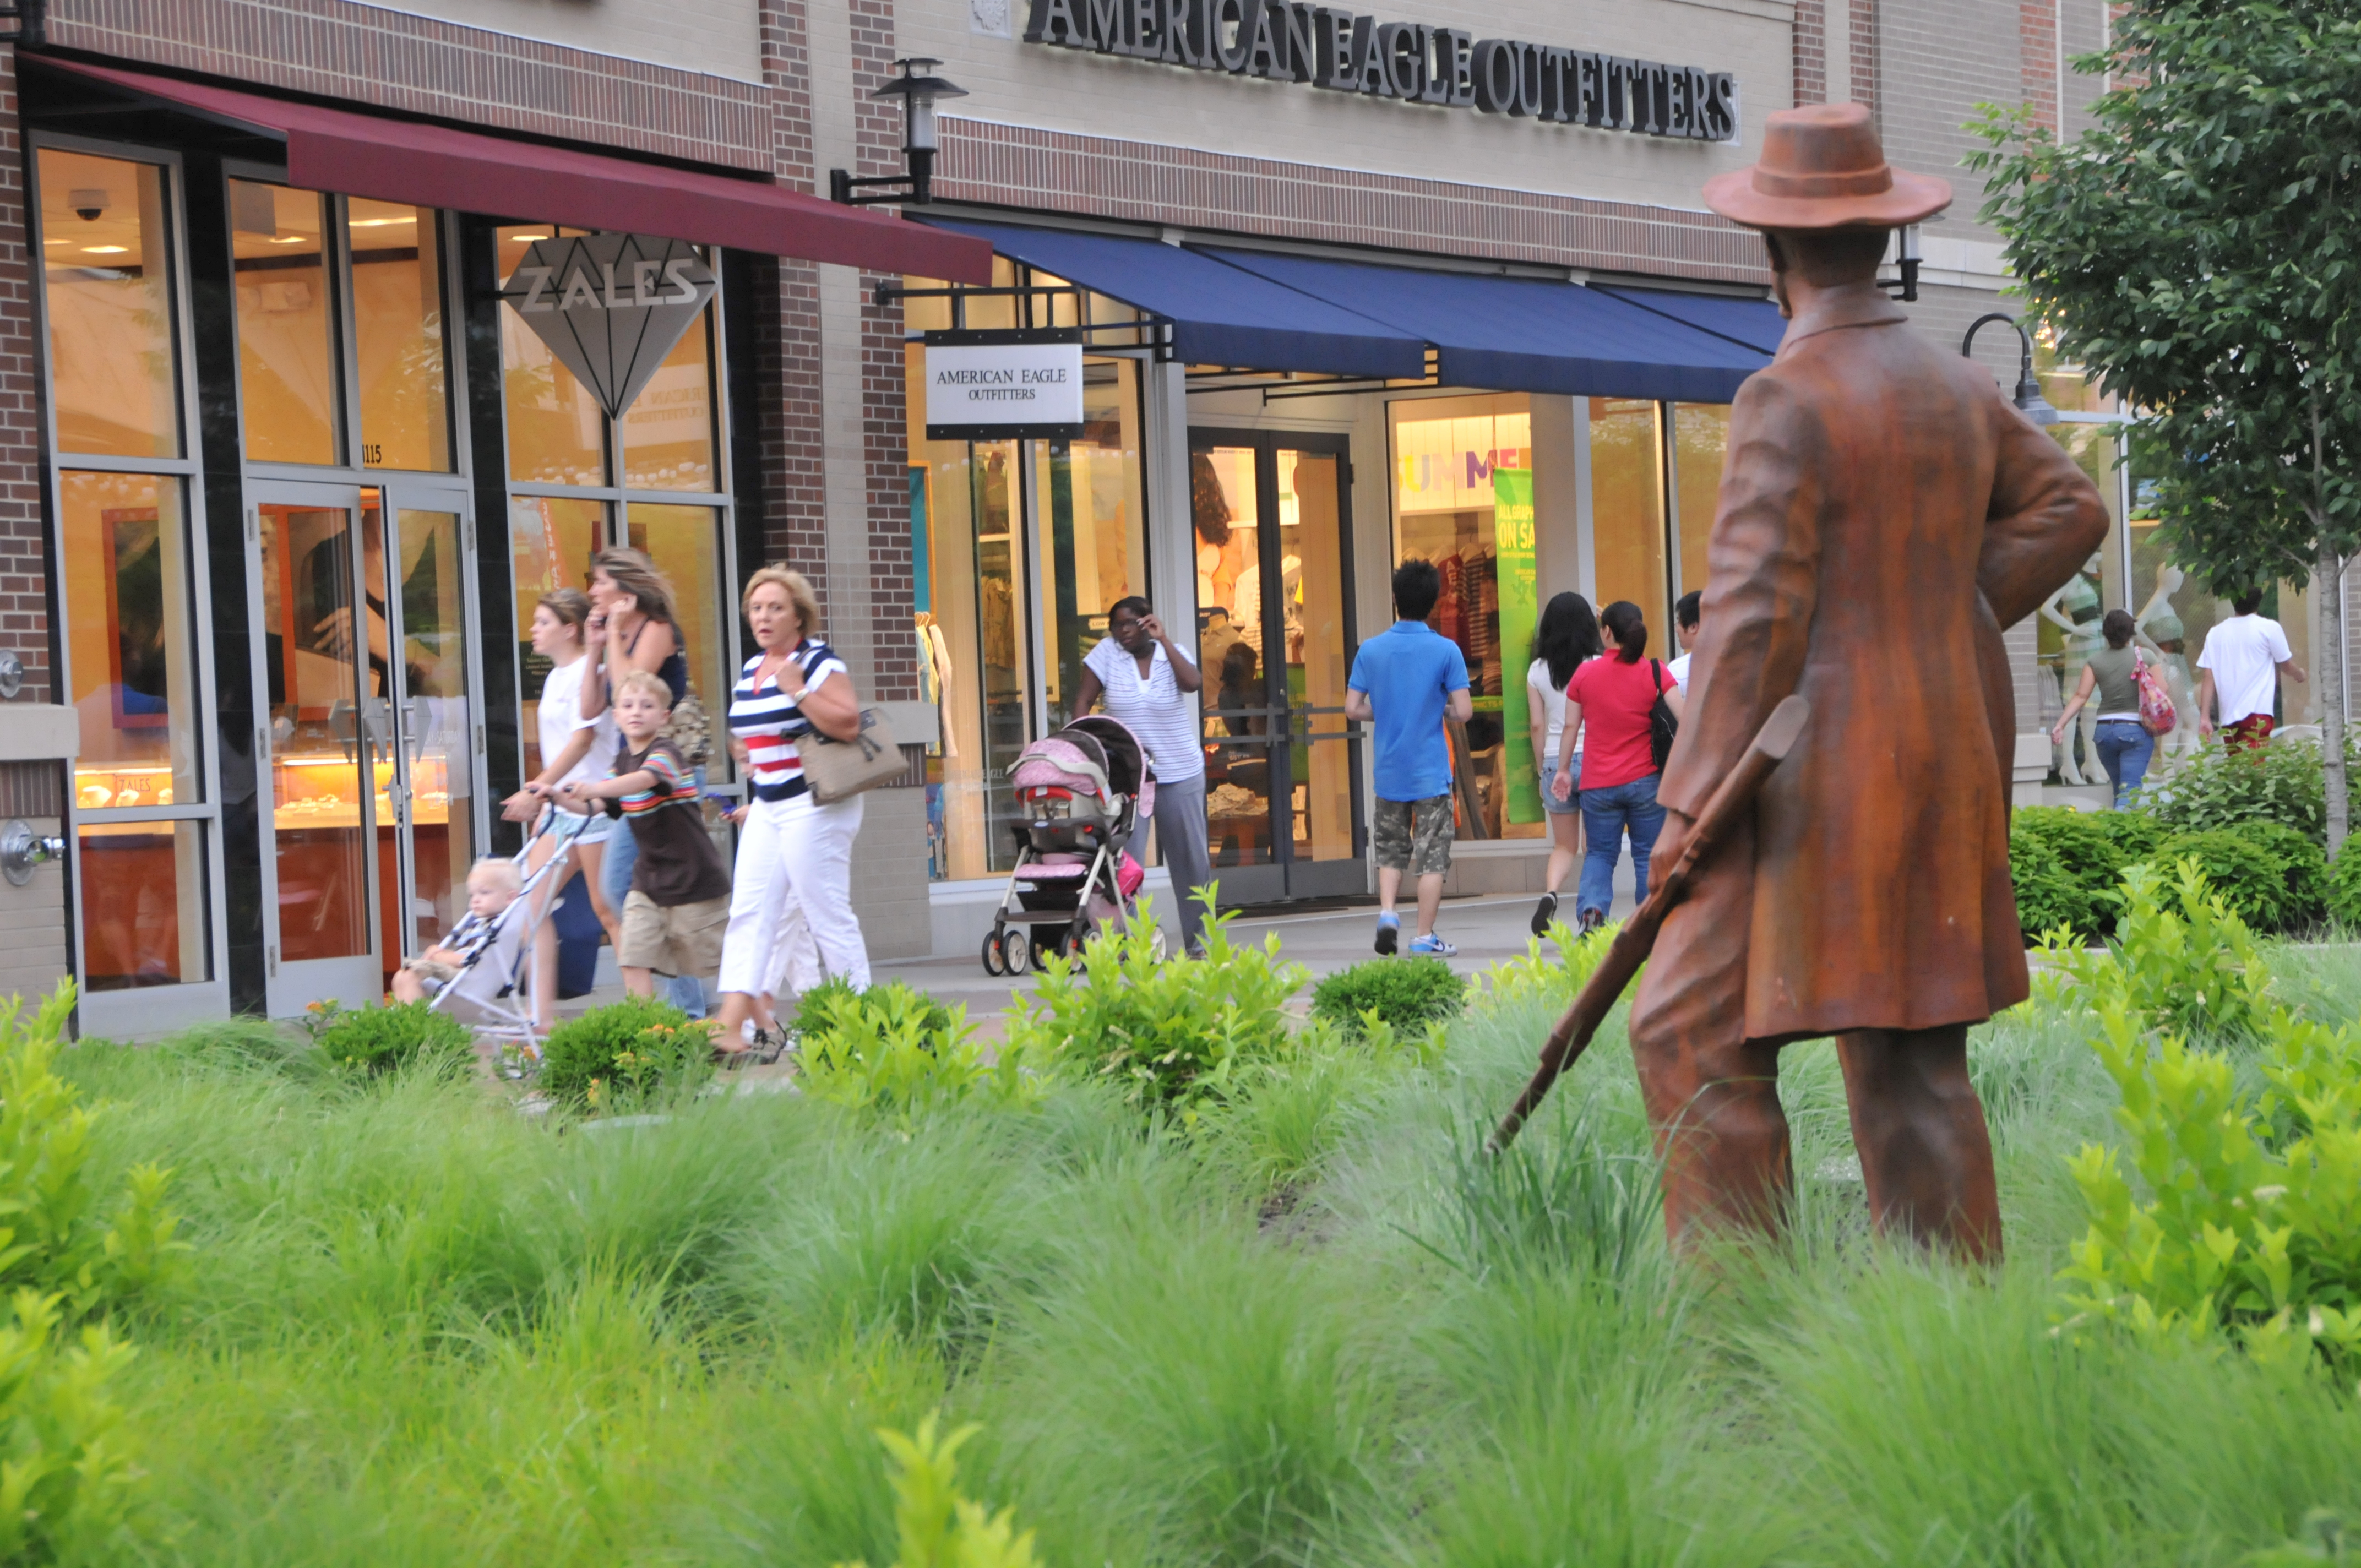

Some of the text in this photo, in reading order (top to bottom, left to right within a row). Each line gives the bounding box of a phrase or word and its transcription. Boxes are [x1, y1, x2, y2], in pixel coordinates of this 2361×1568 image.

[1029, 0, 1736, 141] AMERICAN EAGLE OUTFITTERS
[519, 258, 698, 312] ZALES
[937, 369, 1067, 384] AMERICAN EAGLE
[968, 388, 1036, 400] OUTFITTERS
[1498, 505, 1512, 520] ALL
[1498, 522, 1535, 549] ON SA
[119, 778, 151, 792] ZALES
